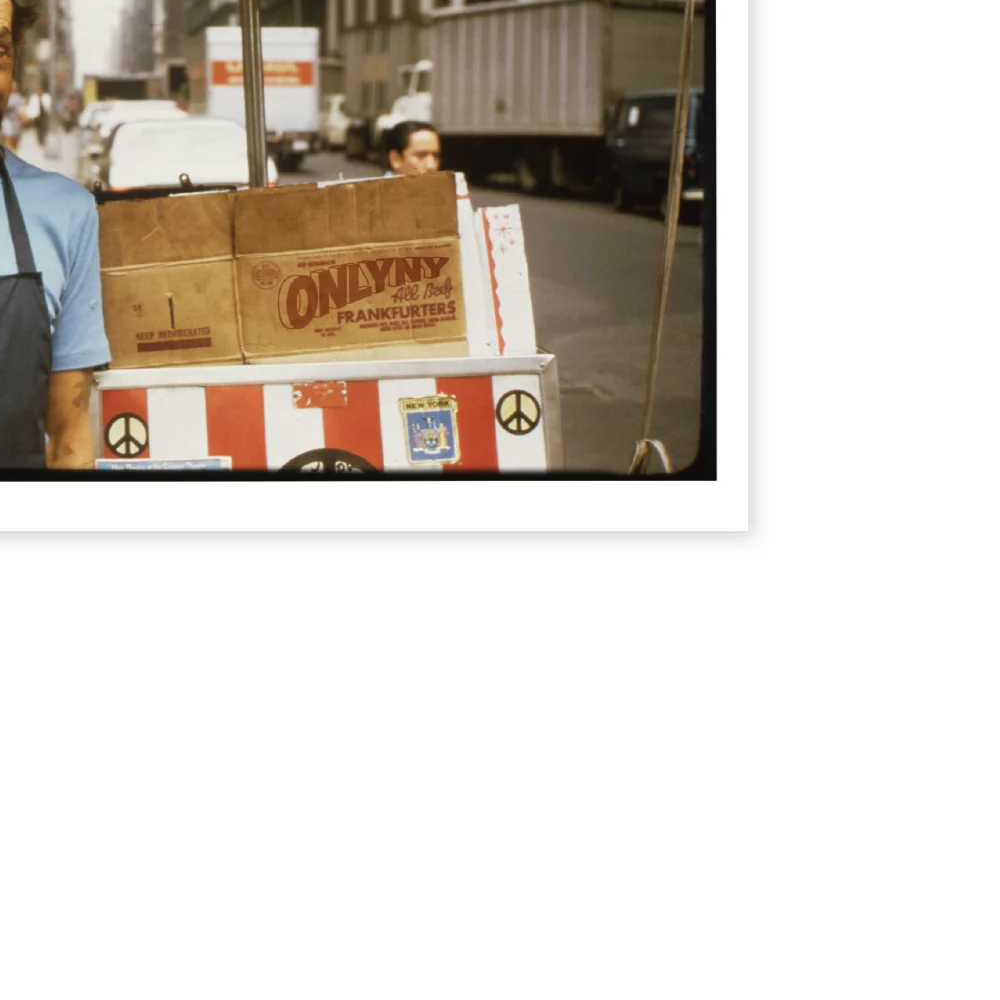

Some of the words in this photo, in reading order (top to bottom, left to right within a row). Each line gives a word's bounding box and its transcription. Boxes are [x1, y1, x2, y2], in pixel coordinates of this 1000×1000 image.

[278, 257, 450, 329] ONLYNY
[391, 285, 420, 304] All
[337, 300, 456, 324] FRANKFURTERS
[406, 401, 424, 409] NEW
[427, 400, 450, 408] YORK
